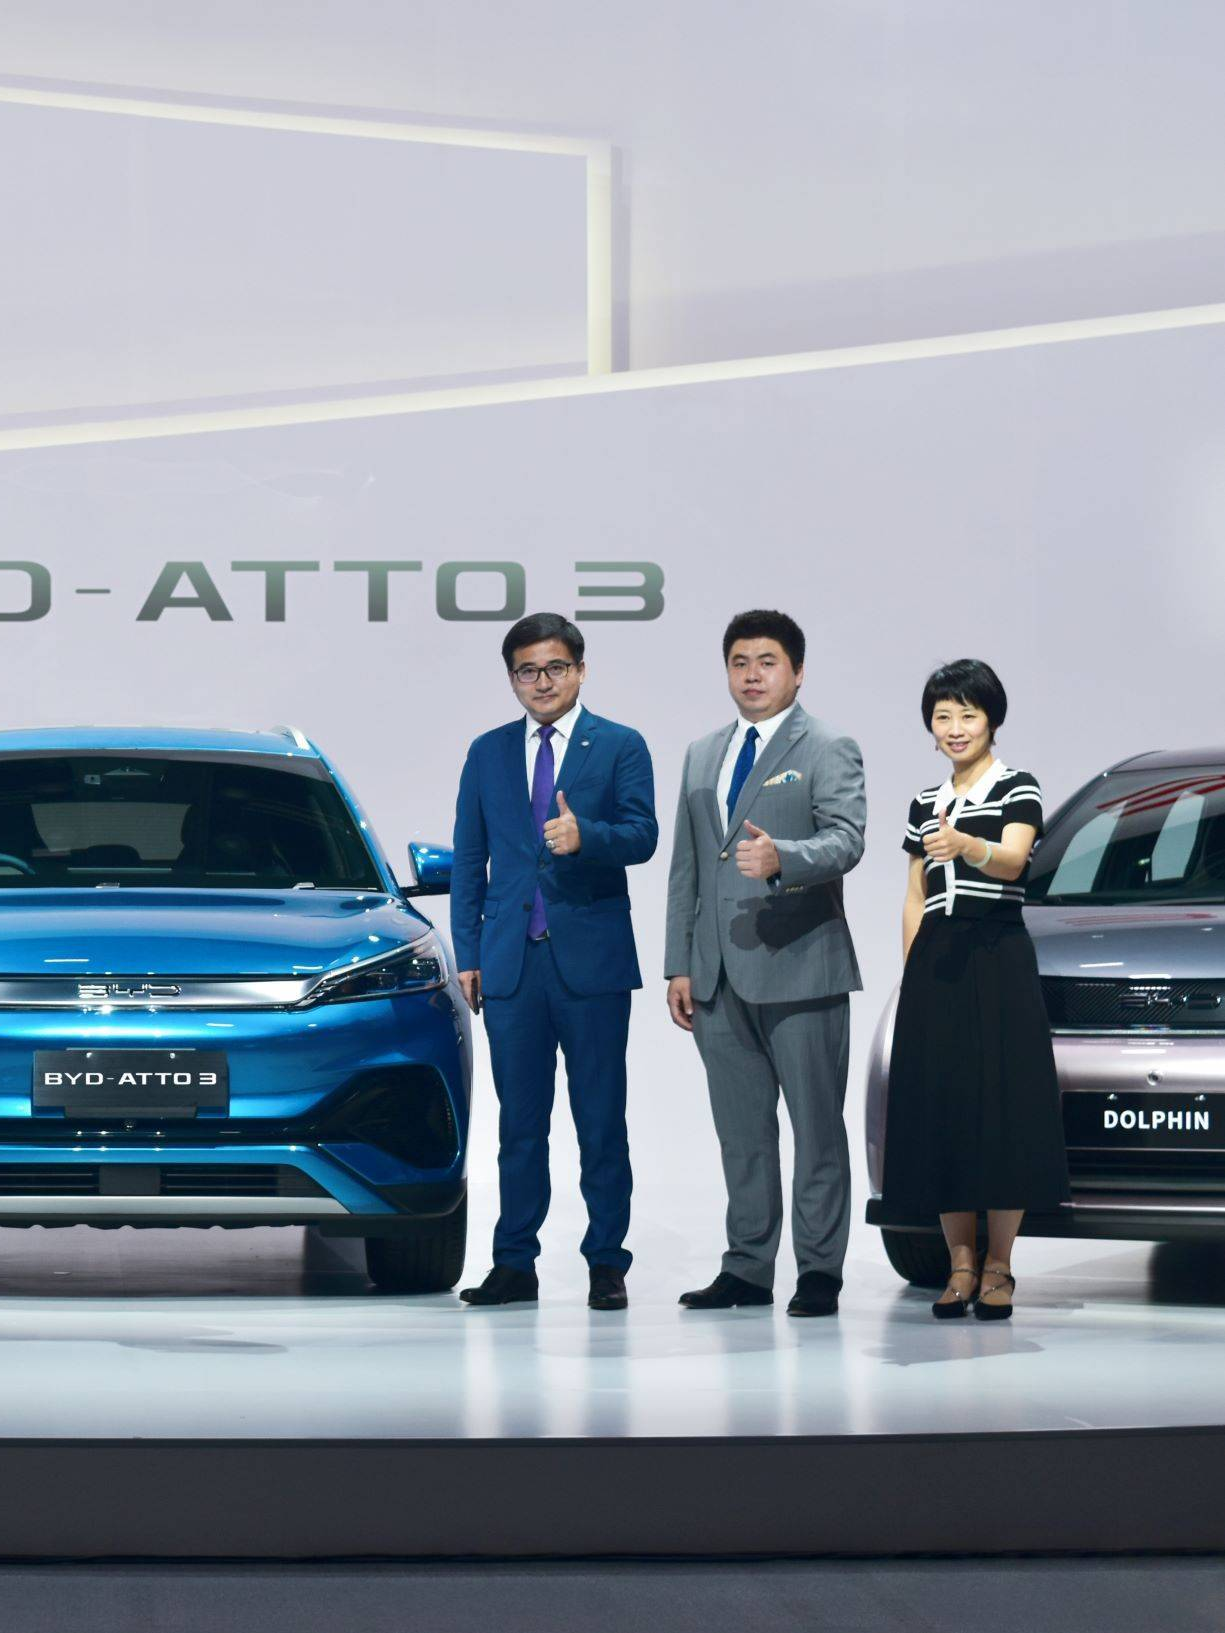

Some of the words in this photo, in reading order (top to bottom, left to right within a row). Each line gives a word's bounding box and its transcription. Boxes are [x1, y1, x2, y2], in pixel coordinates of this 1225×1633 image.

[574, 561, 665, 622] 3
[78, 984, 181, 998] BYD
[44, 1072, 192, 1086] BYD-ATTO
[198, 1072, 217, 1086] 3
[1103, 1110, 1210, 1130] DOLPHIN
